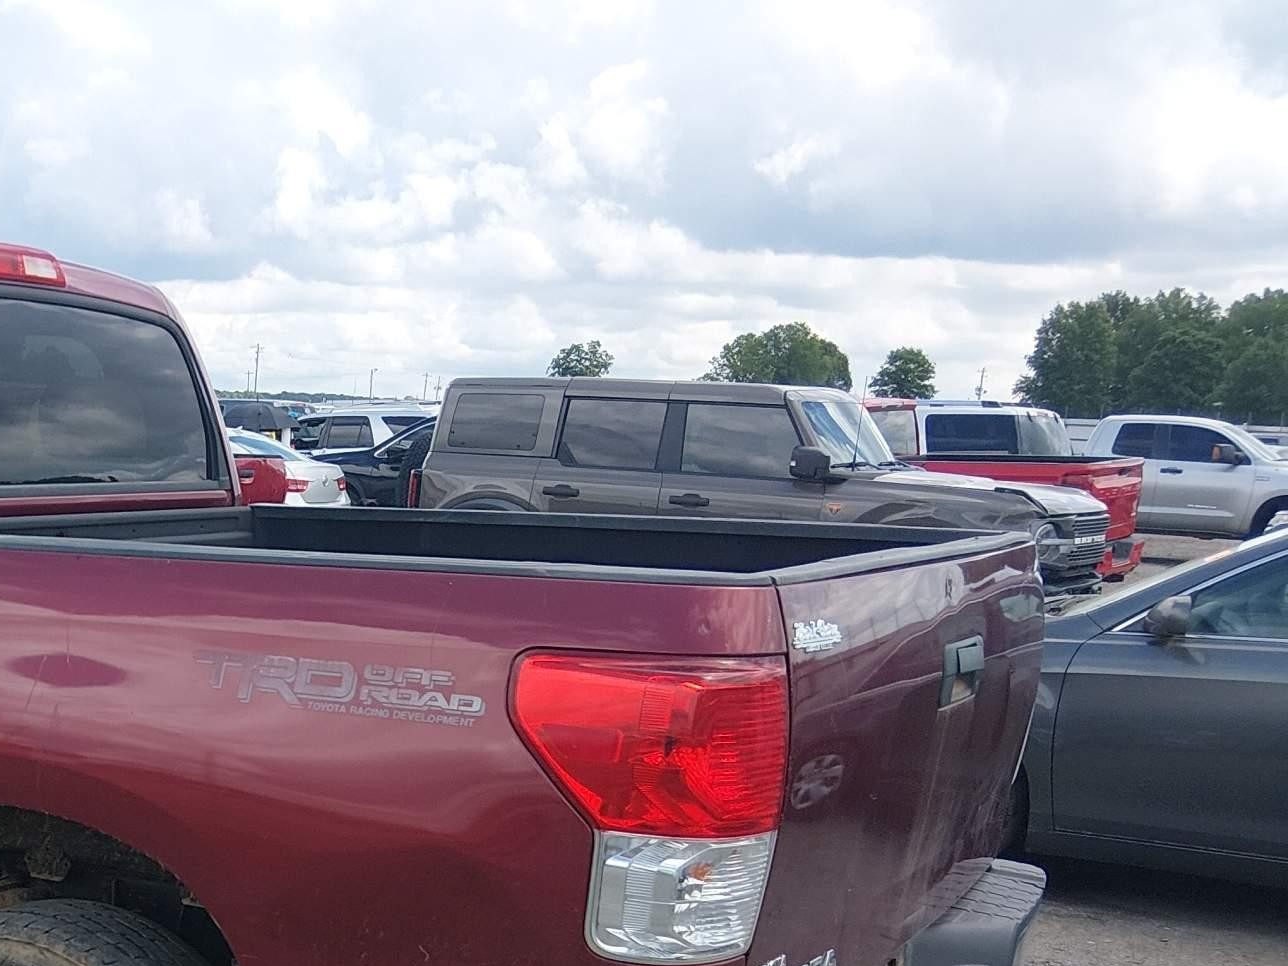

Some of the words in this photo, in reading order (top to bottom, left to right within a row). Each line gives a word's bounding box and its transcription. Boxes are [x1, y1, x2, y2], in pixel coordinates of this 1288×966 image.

[194, 651, 358, 708] TRD
[362, 664, 455, 688] OFF
[307, 701, 347, 714] TOYOTA
[349, 706, 390, 719] RACING
[392, 710, 475, 728] DEVELOPMENT
[361, 685, 486, 716] ROAD
